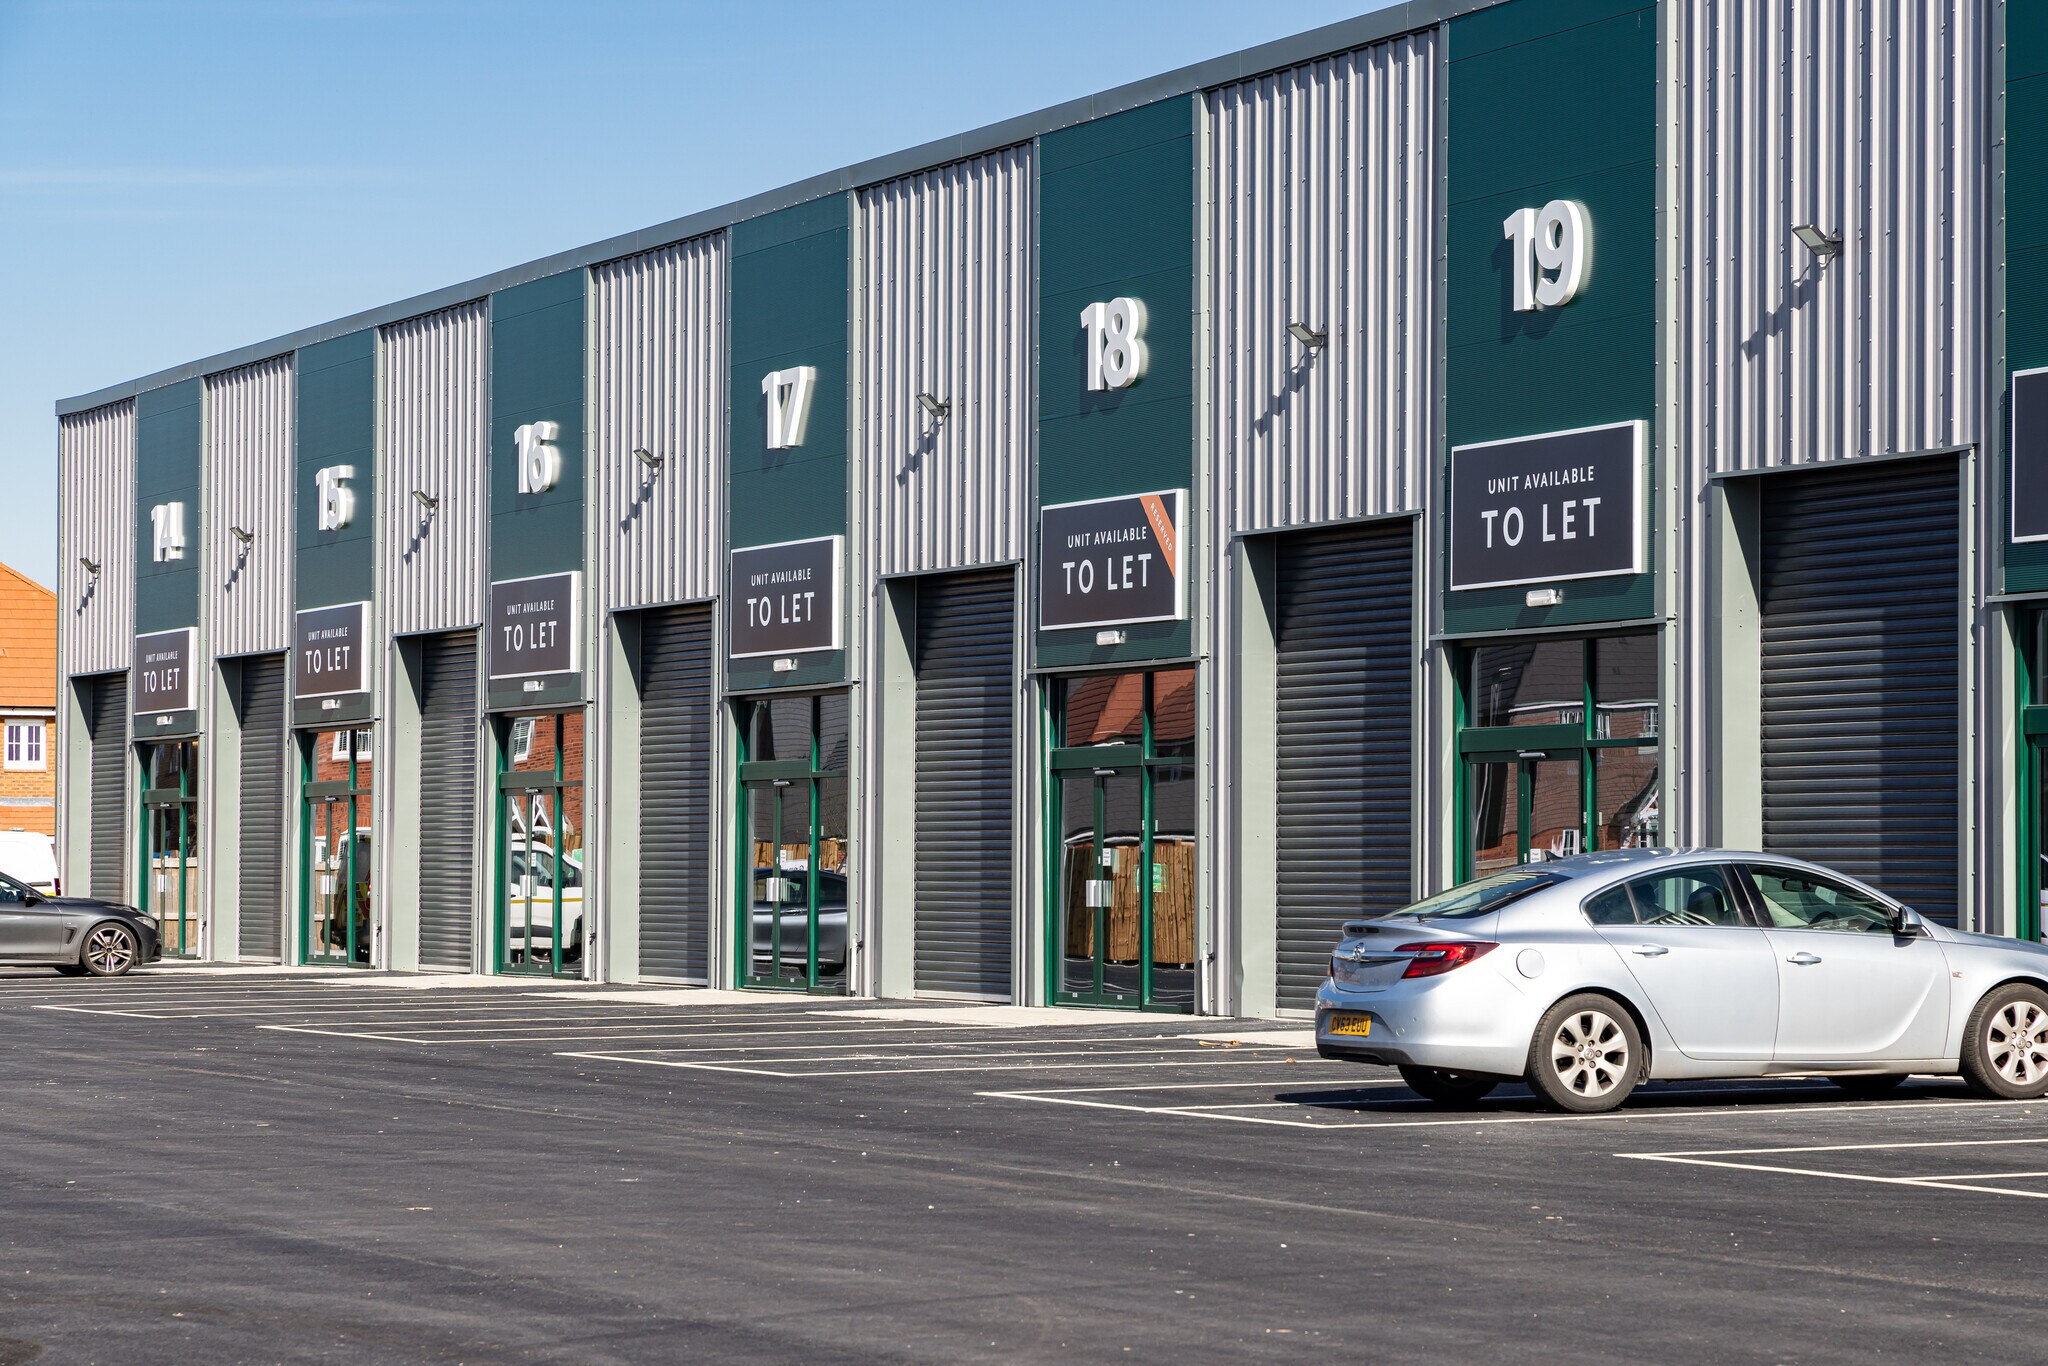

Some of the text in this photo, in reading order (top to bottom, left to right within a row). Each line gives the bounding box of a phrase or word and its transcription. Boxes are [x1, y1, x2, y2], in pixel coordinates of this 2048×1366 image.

[1503, 200, 1592, 311] 19
[1080, 297, 1148, 391] 18
[761, 366, 815, 449] 17
[514, 421, 561, 494] 16
[315, 465, 355, 530] 15
[1488, 466, 1595, 495] UNIT AVAILABLE
[151, 502, 185, 562] 14
[1067, 525, 1147, 549] UNIT AVAILABLE
[1150, 502, 1173, 552] RESERVED
[1481, 497, 1601, 549] TO LET
[750, 567, 811, 587] UNIT AVAILABLE
[1062, 552, 1152, 595] TO LET
[506, 600, 555, 616] UNIT AVAILABLE
[747, 591, 815, 628] TO LET
[308, 627, 348, 642] UNIT AVAILABLE
[504, 621, 558, 652] TO LET
[145, 650, 179, 664] UNIT AVAILABLE
[305, 645, 350, 675] TO LET
[143, 668, 180, 694] TO LET
